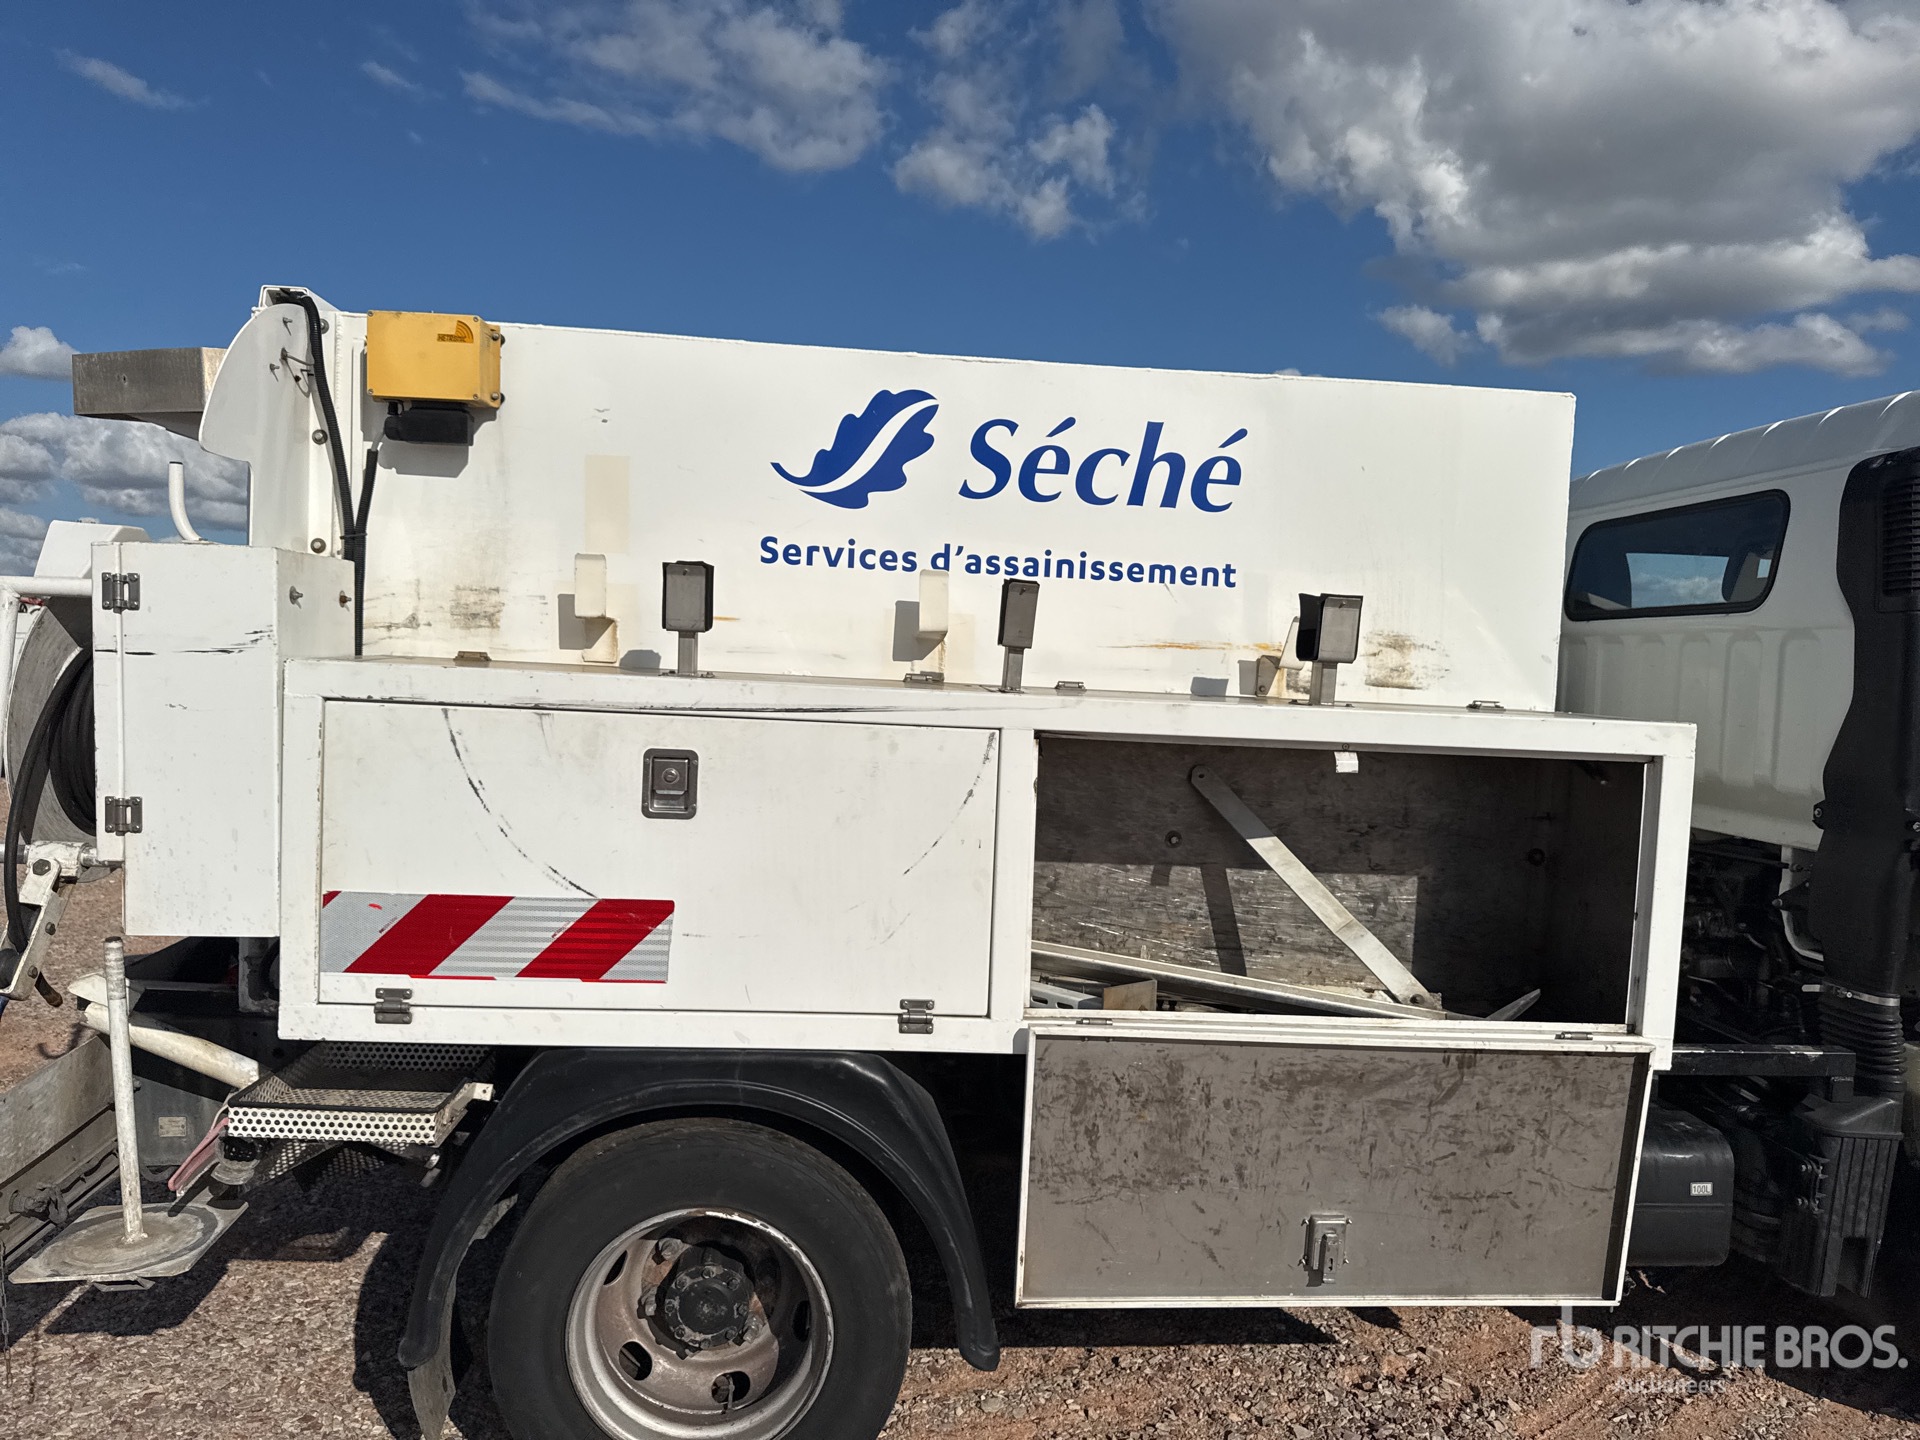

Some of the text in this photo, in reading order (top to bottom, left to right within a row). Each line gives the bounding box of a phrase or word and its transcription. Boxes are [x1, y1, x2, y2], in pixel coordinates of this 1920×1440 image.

[959, 417, 1248, 513] Séché
[760, 536, 1237, 588] Services d'assainissement
[1692, 1184, 1711, 1194] 100L
